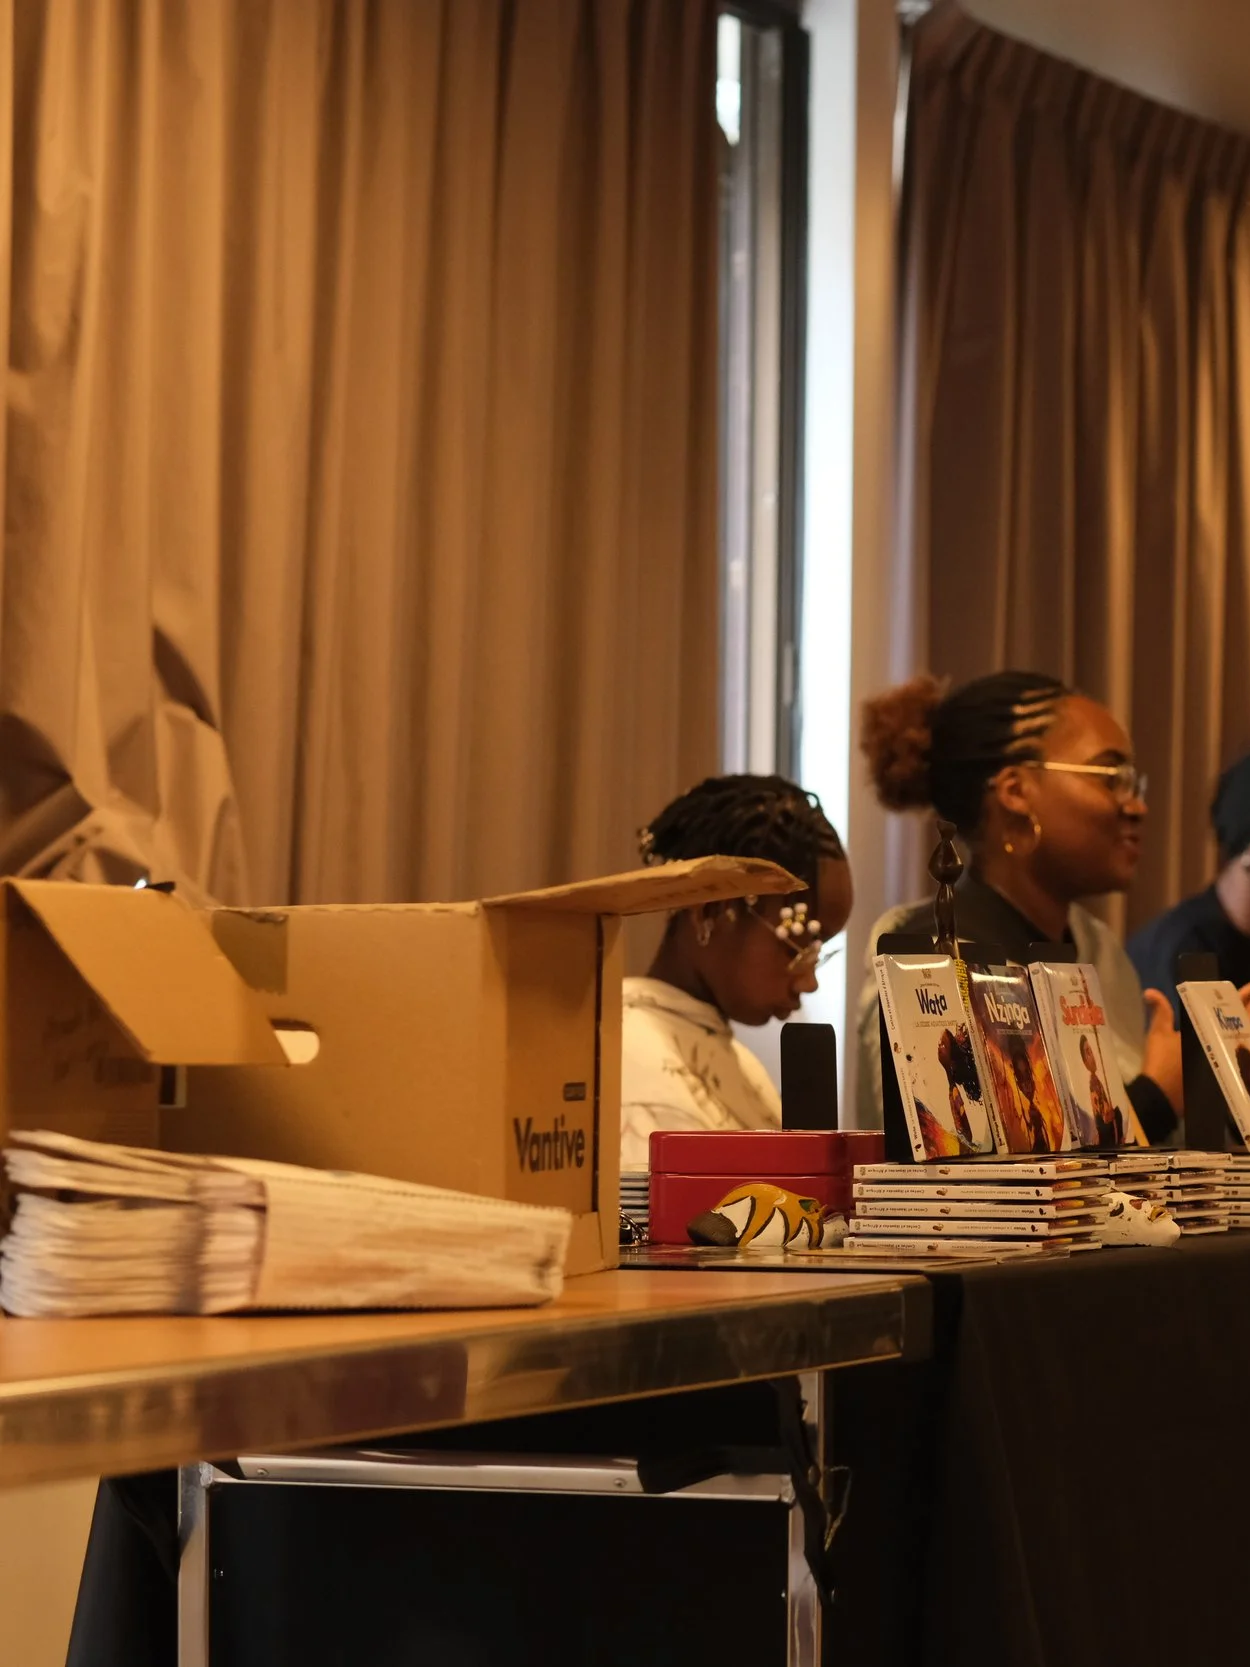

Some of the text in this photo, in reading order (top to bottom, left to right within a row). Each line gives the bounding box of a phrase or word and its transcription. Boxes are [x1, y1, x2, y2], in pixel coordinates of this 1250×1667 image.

[915, 988, 948, 1016] Wata
[983, 992, 1031, 1030] Nzinga
[513, 1114, 585, 1173] Vantive
